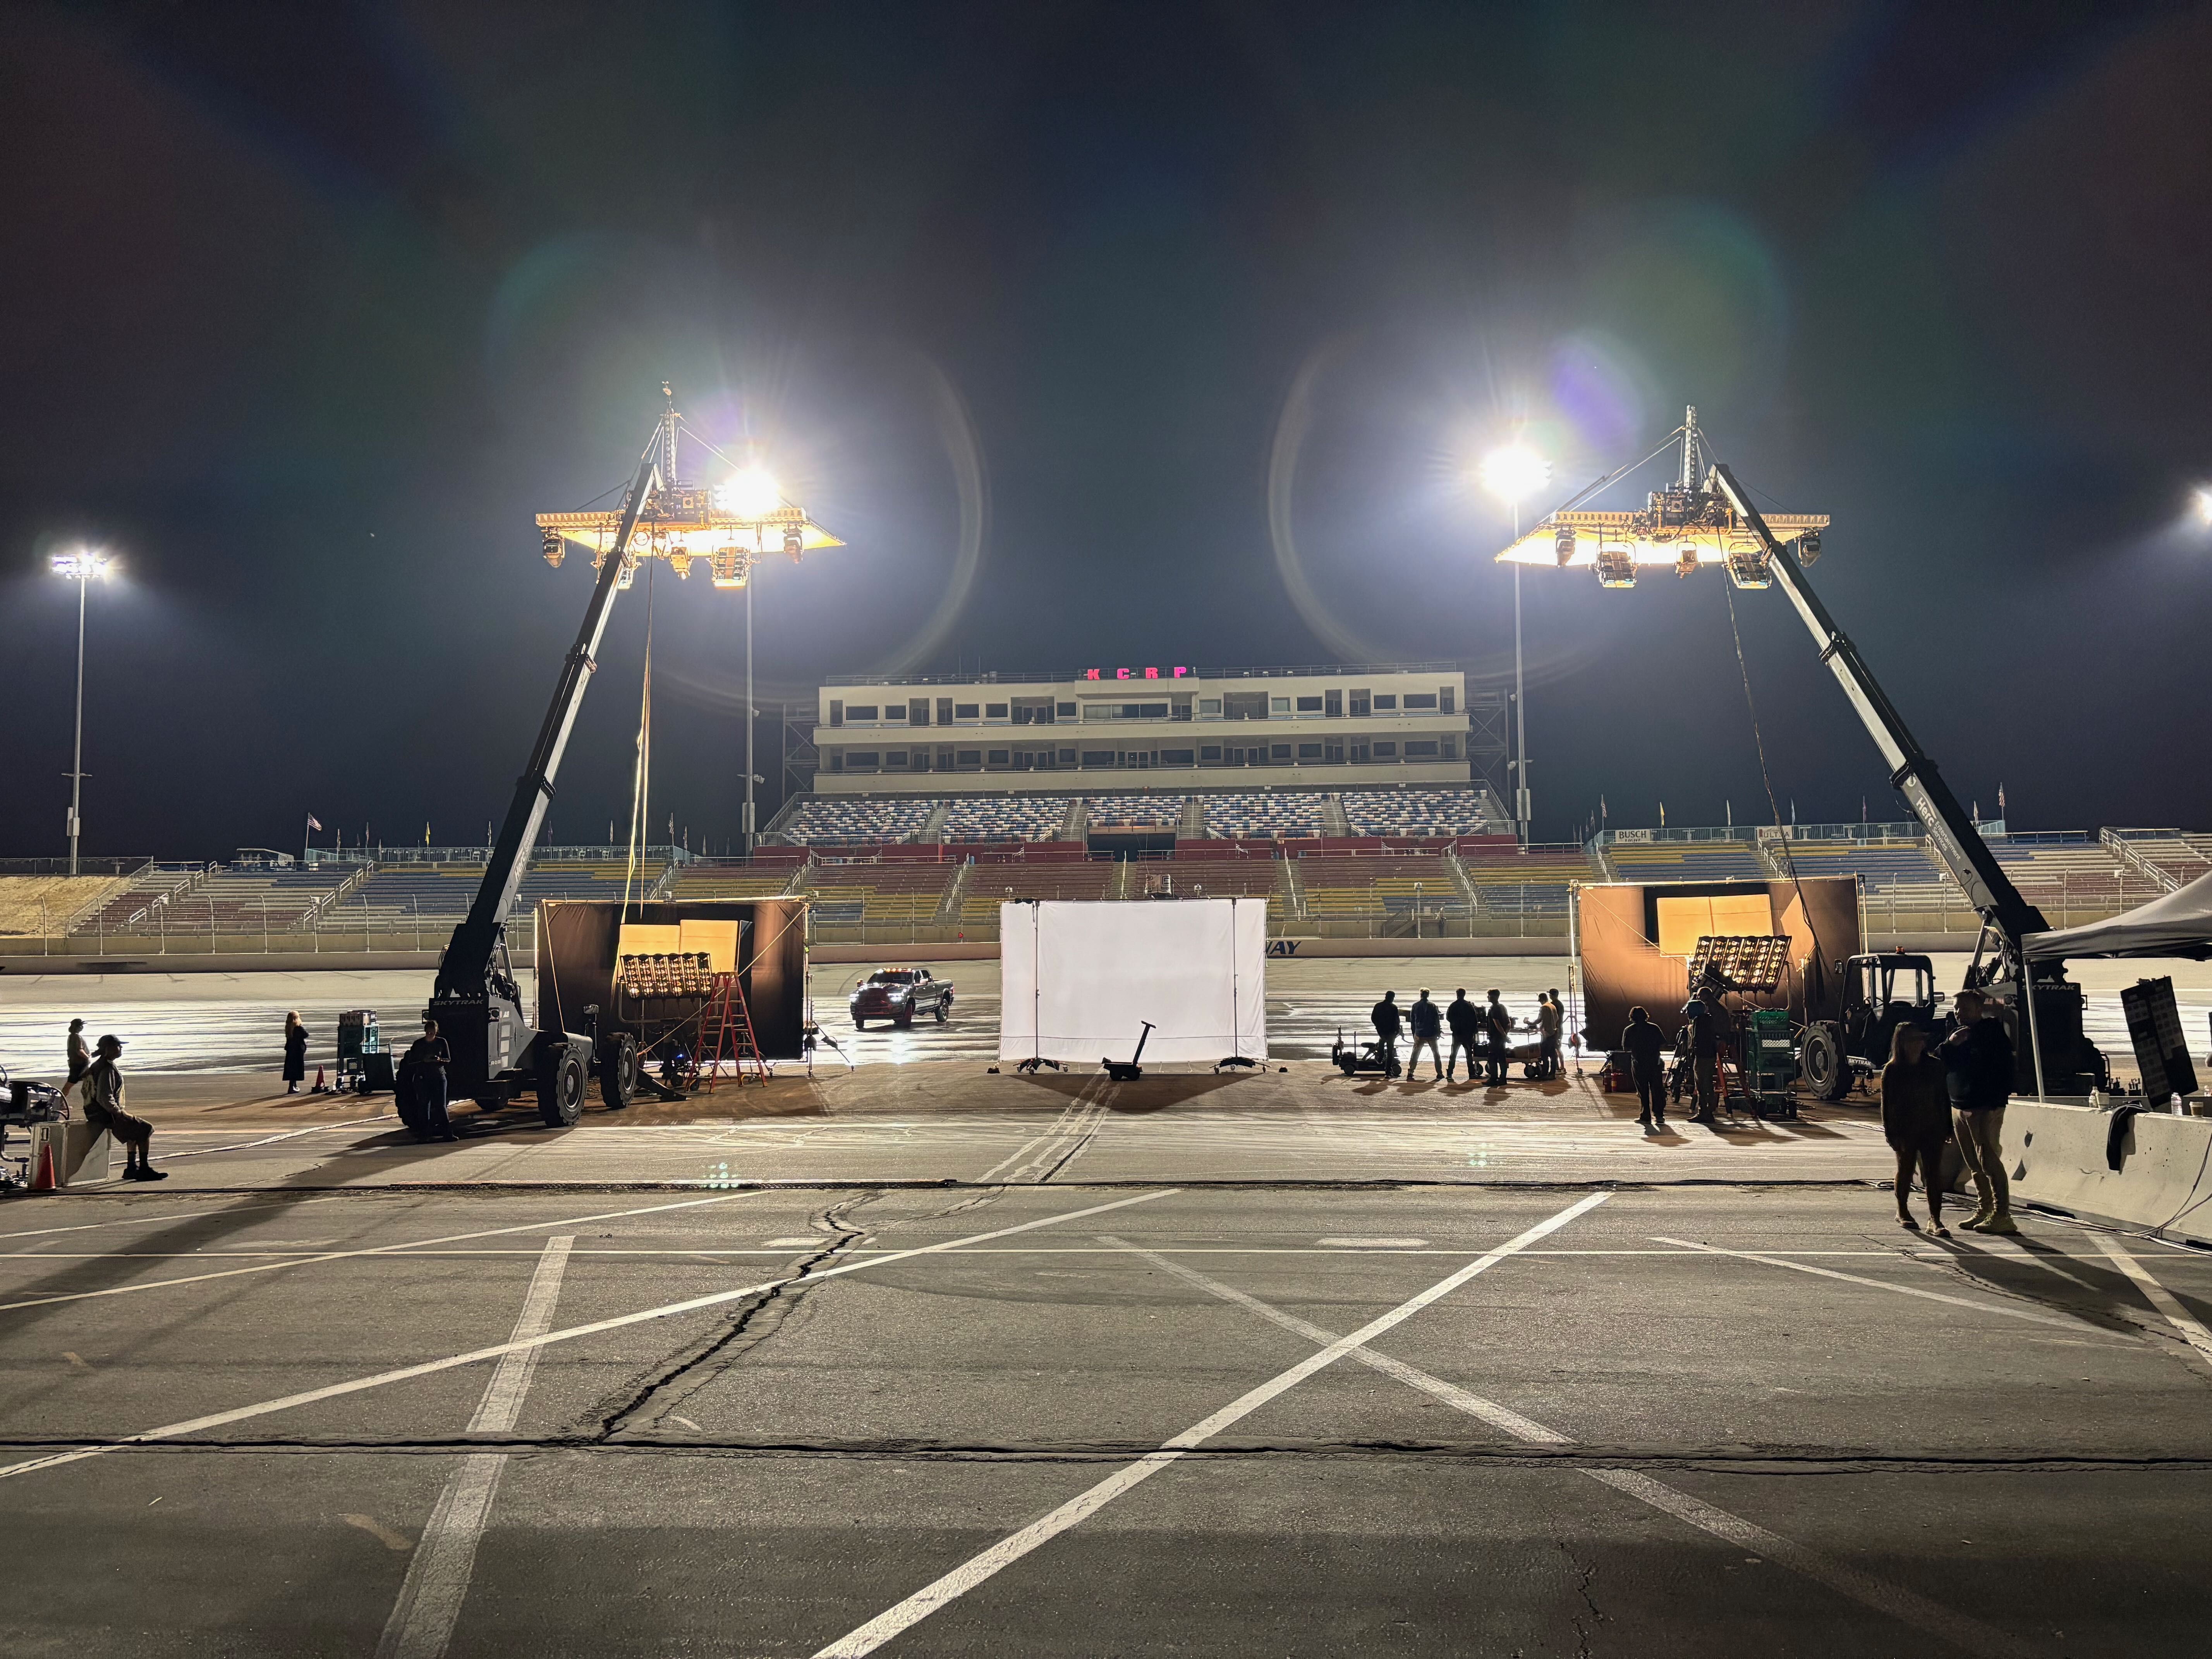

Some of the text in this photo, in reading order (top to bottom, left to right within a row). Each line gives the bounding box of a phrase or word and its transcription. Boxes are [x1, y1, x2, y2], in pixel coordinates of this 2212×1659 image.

[1916, 797, 1934, 827] Herc
[1619, 830, 1646, 839] BUSCH
[1932, 826, 1948, 852] Services
[1935, 821, 1961, 862] Entertainment
[514, 852, 526, 883] Herc
